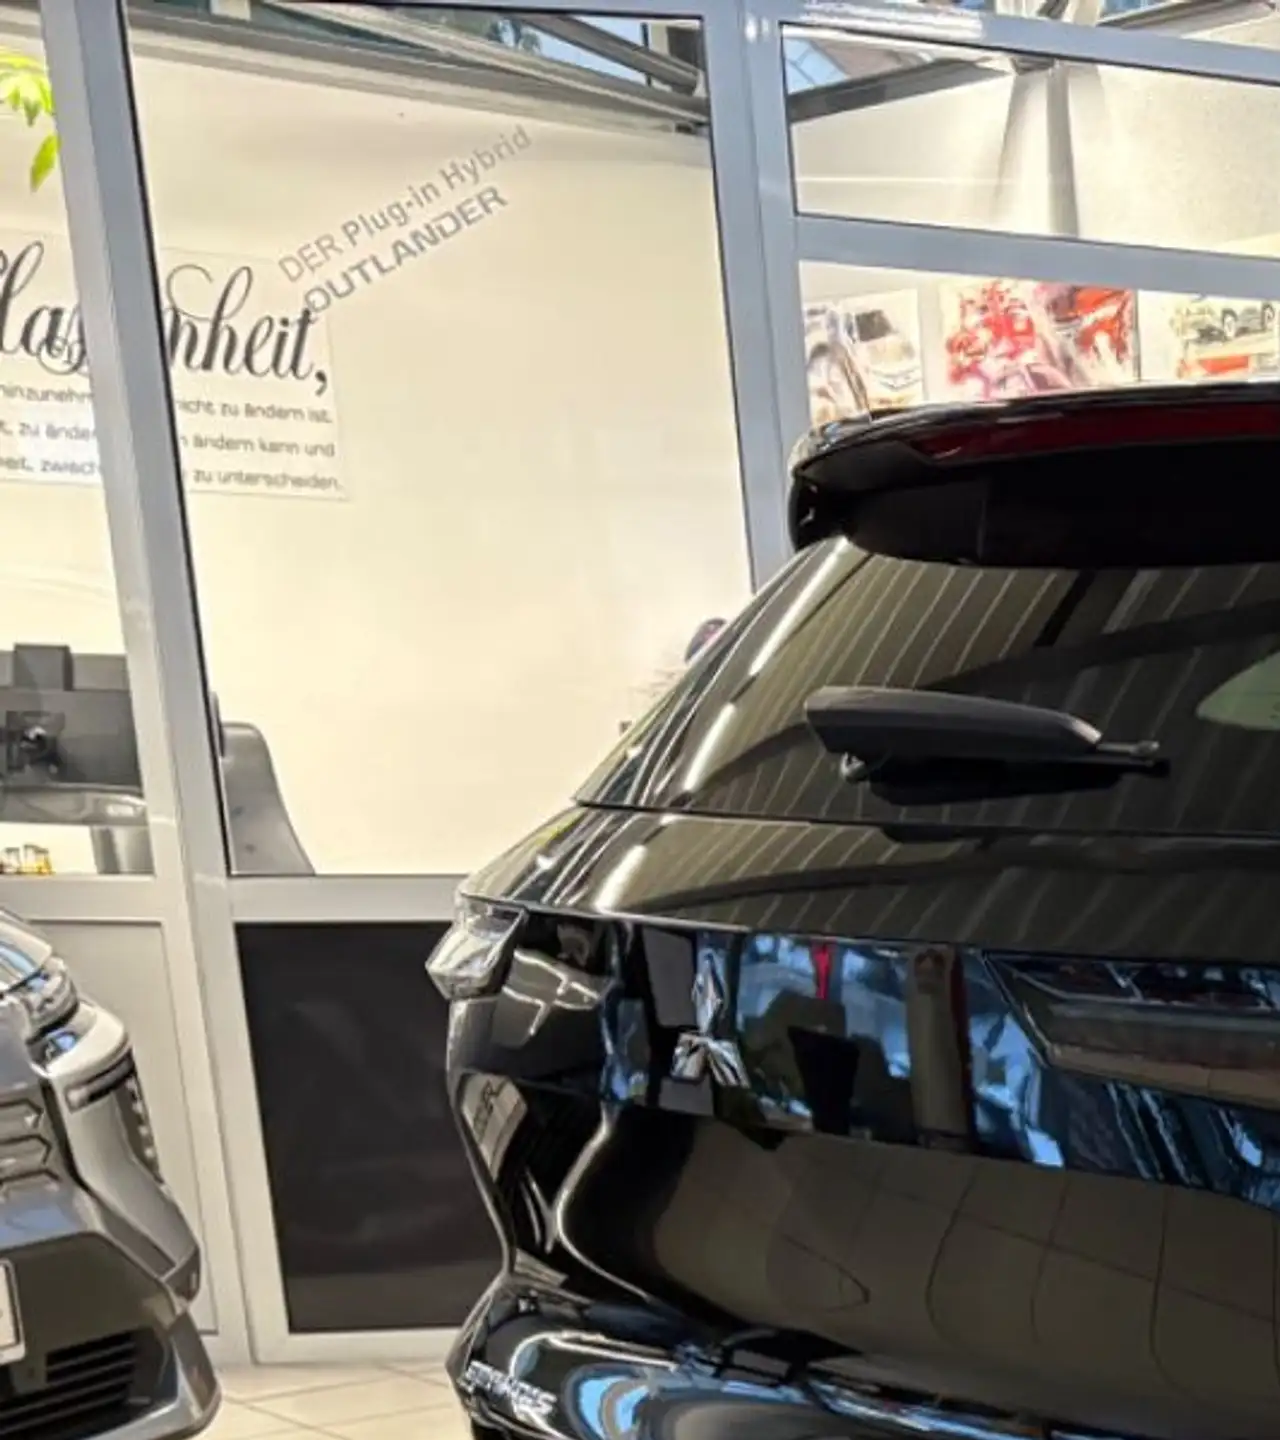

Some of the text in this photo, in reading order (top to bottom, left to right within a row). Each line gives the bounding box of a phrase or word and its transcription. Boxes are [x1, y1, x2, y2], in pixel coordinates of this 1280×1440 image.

[278, 125, 532, 283] DER Plug-in Hybrid
[303, 186, 508, 313] OUTLANDER
